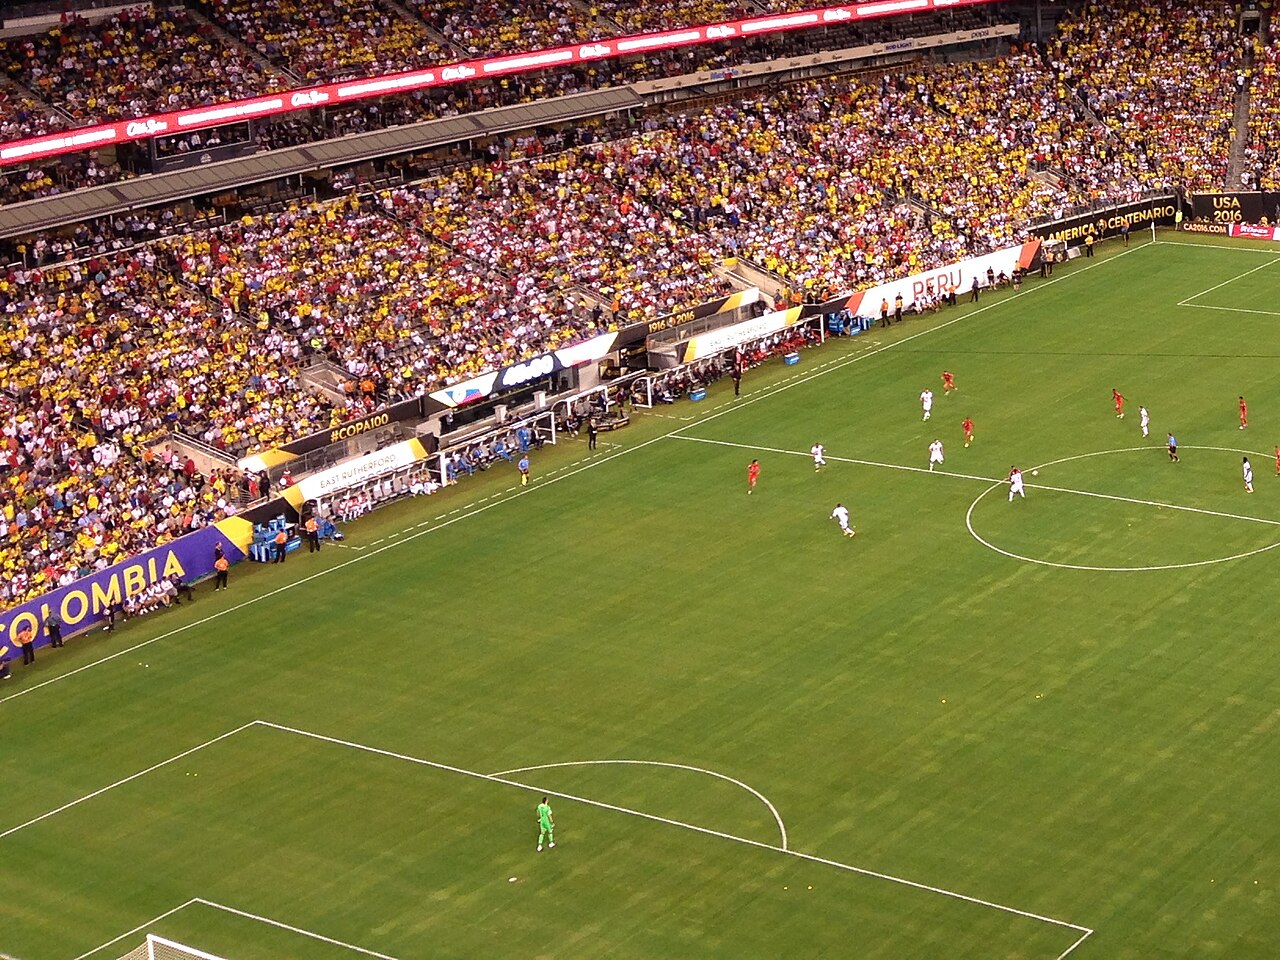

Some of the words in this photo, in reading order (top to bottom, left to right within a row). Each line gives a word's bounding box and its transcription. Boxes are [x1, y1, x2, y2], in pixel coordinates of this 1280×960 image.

[1213, 196, 1241, 209] USA
[1048, 223, 1097, 241] AMERICA
[1107, 205, 1176, 229] CENTENARIO
[1213, 209, 1242, 222] 2016
[1183, 222, 1227, 235] CA2016.COM
[913, 269, 962, 302] PERU
[648, 320, 666, 333] 1916
[330, 413, 389, 442] #COPA100
[320, 474, 340, 489] EAST
[341, 453, 396, 480] RUTHERFORD
